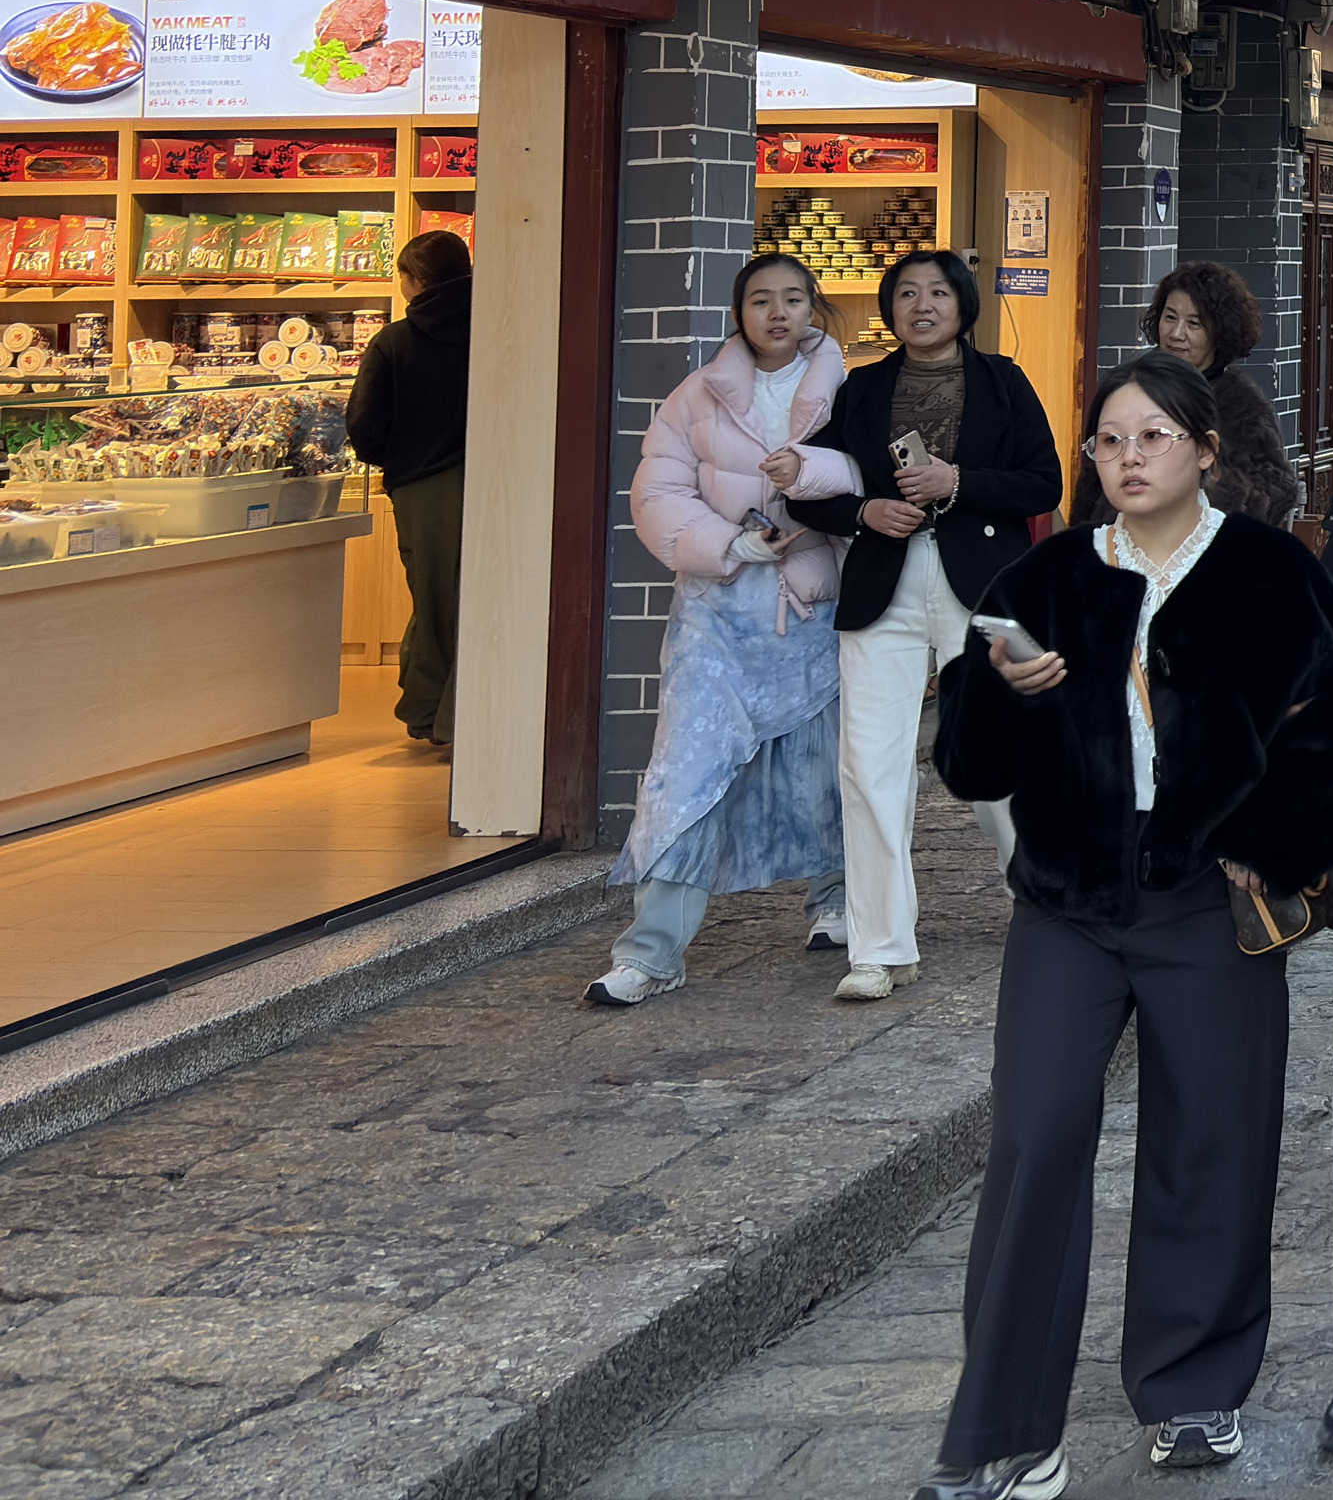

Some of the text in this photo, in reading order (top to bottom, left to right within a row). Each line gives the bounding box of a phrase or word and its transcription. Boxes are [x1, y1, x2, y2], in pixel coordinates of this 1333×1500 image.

[151, 16, 233, 30] YAKMEAT
[431, 12, 480, 26] YAKM
[151, 34, 271, 52] 现做牦牛腱子肉
[430, 29, 482, 46] 当天现
[766, 89, 808, 98] 自然好味
